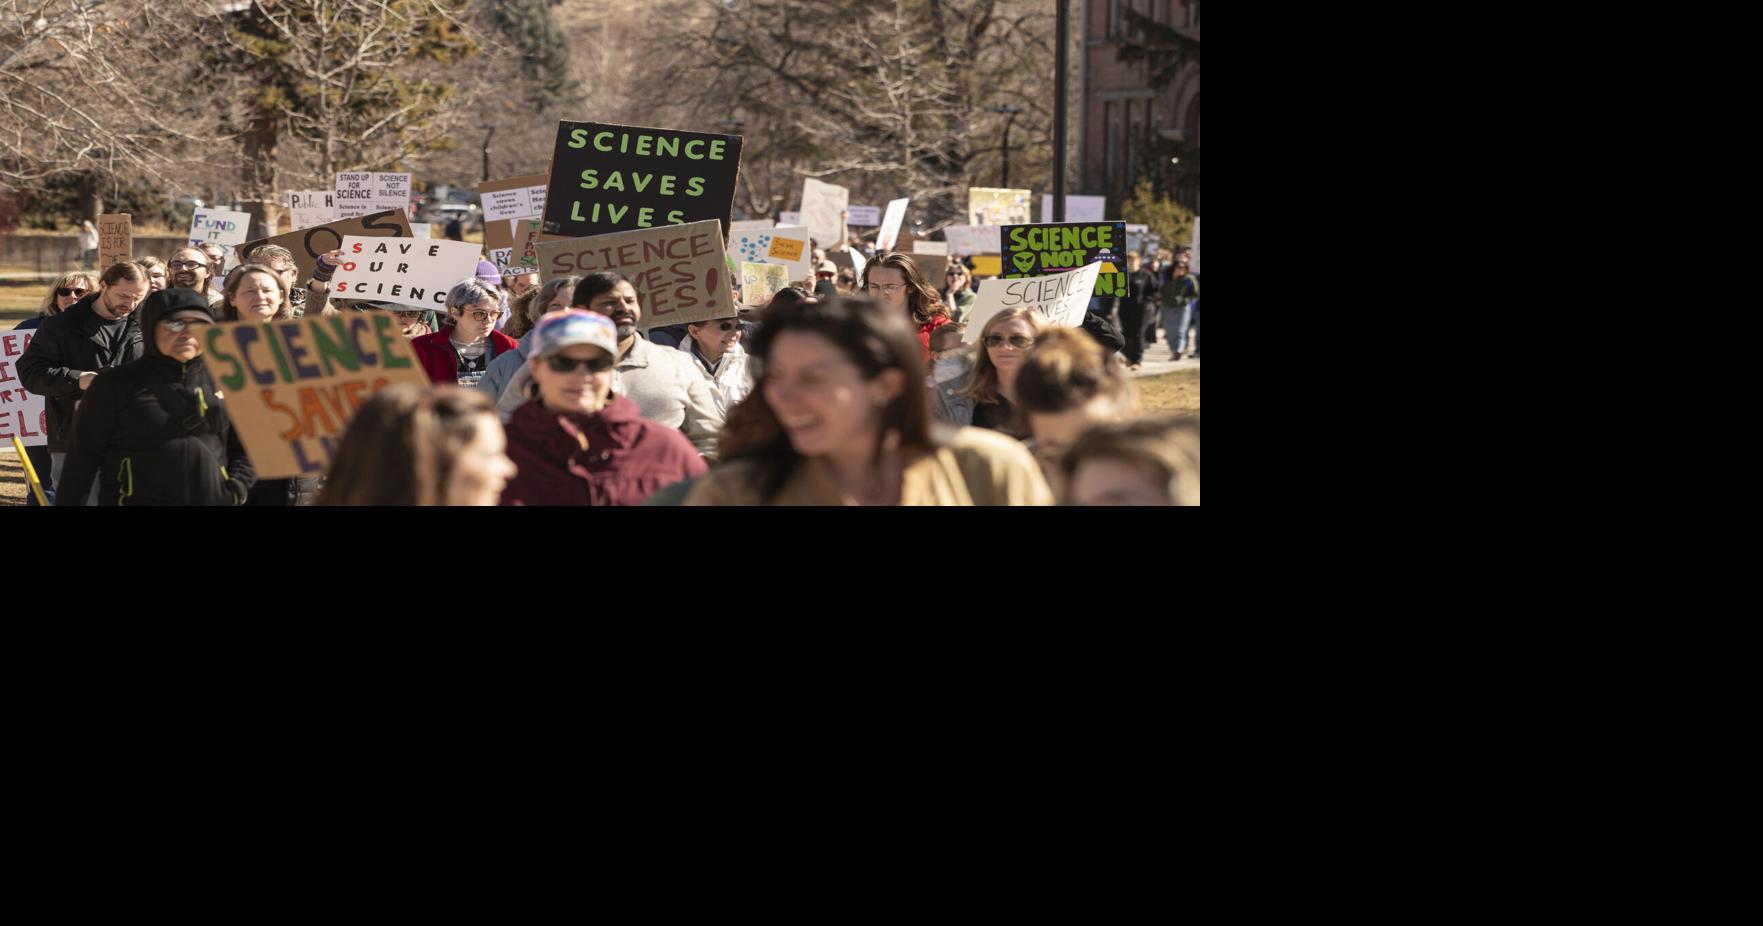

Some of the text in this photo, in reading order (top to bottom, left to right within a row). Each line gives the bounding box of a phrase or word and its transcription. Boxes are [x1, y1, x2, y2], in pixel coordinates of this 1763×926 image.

[568, 128, 726, 161] SCIENCE
[379, 174, 408, 182] SCIENCE
[386, 182, 400, 190] NOT
[580, 169, 706, 197] SAVES
[337, 189, 371, 199] SCIENCE
[379, 189, 407, 198] SILENCE
[194, 214, 235, 231] FUND
[571, 200, 685, 228] LIVES
[208, 231, 221, 239] IT
[1009, 225, 1113, 251] SCIENCE
[353, 242, 440, 257] SAVE
[552, 233, 714, 275] SCIENCE
[1040, 250, 1087, 267] NOT
[342, 262, 409, 274] OUR
[336, 281, 447, 304] SCIENC
[1001, 269, 1088, 306] SCIENCE
[207, 315, 411, 392] SCIENCE
